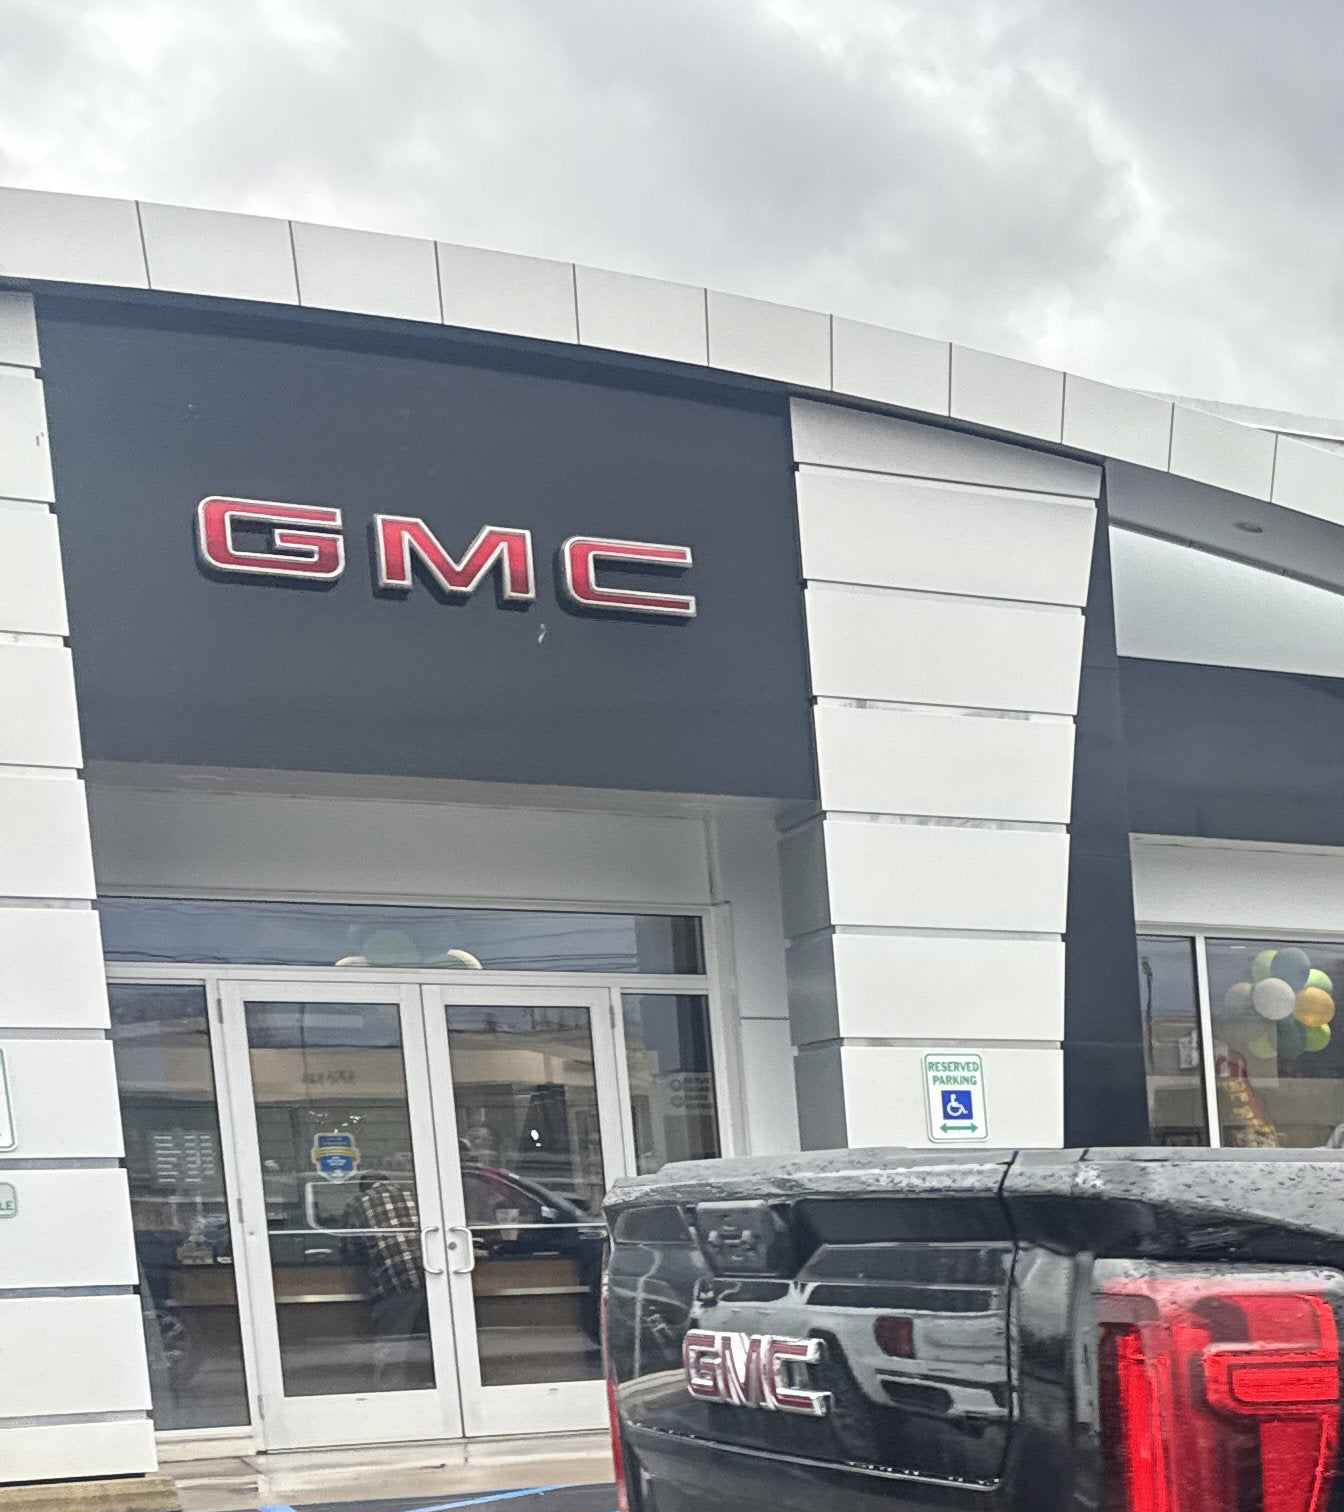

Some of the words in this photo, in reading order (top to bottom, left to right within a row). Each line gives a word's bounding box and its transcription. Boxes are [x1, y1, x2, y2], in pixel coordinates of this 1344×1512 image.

[197, 496, 697, 617] GMC
[927, 1061, 979, 1073] RESERVED
[932, 1075, 978, 1086] PARKING
[683, 1328, 834, 1418] GMC
